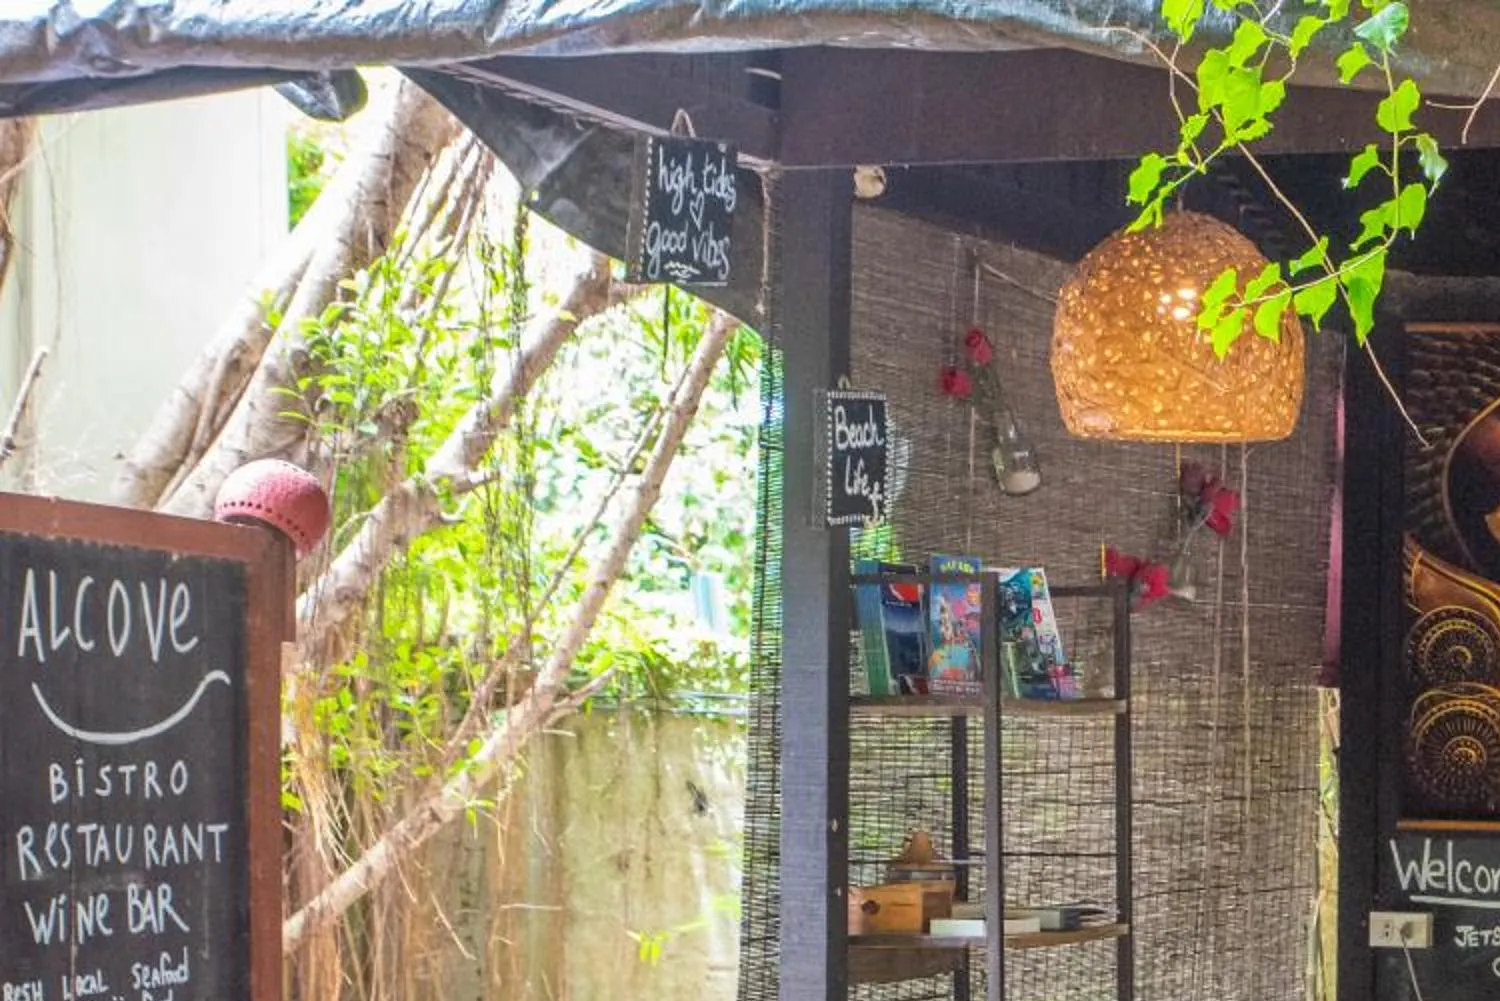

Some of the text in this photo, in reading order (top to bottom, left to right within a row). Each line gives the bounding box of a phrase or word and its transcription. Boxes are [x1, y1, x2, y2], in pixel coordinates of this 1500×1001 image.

[659, 143, 698, 215] high
[646, 221, 689, 279] good
[834, 404, 885, 450] Beach
[127, 883, 190, 933] BAR
